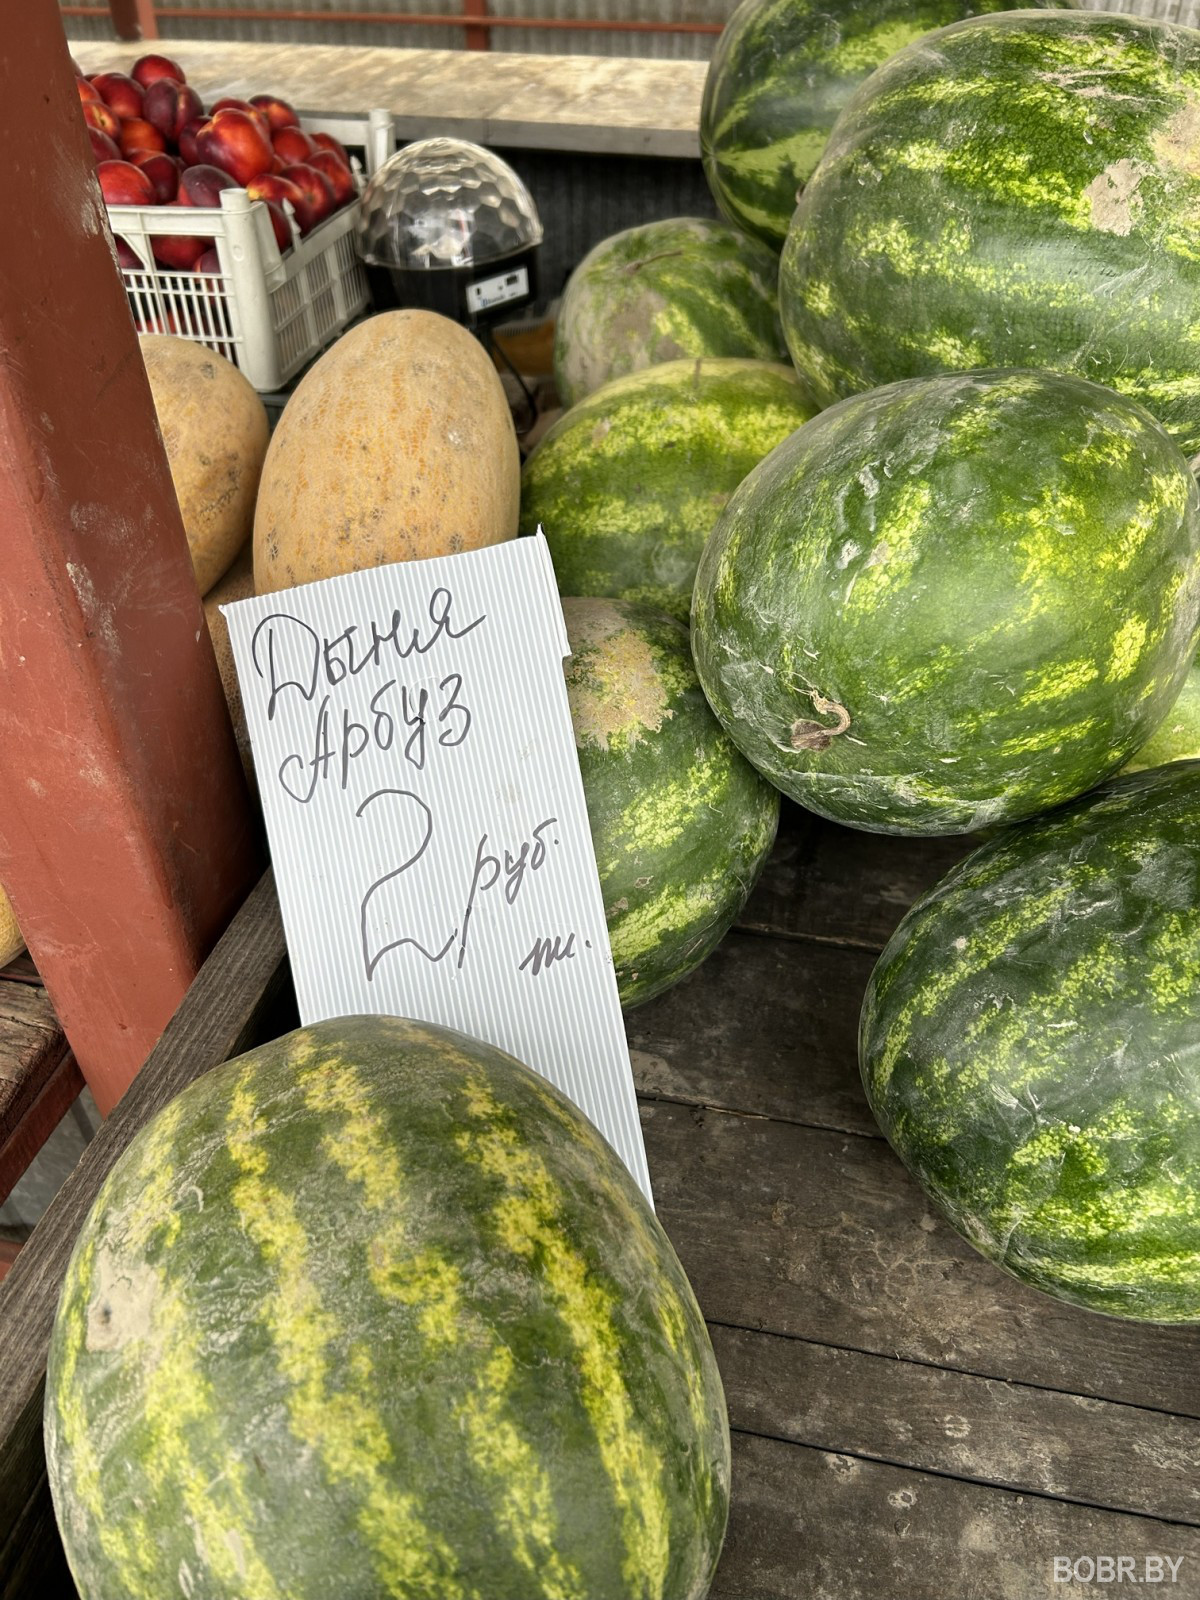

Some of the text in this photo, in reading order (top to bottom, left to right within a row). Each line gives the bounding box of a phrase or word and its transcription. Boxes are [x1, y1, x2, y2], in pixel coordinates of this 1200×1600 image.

[252, 587, 487, 721] Дыня
[278, 672, 472, 804] Арбуз
[356, 788, 458, 981] 2
